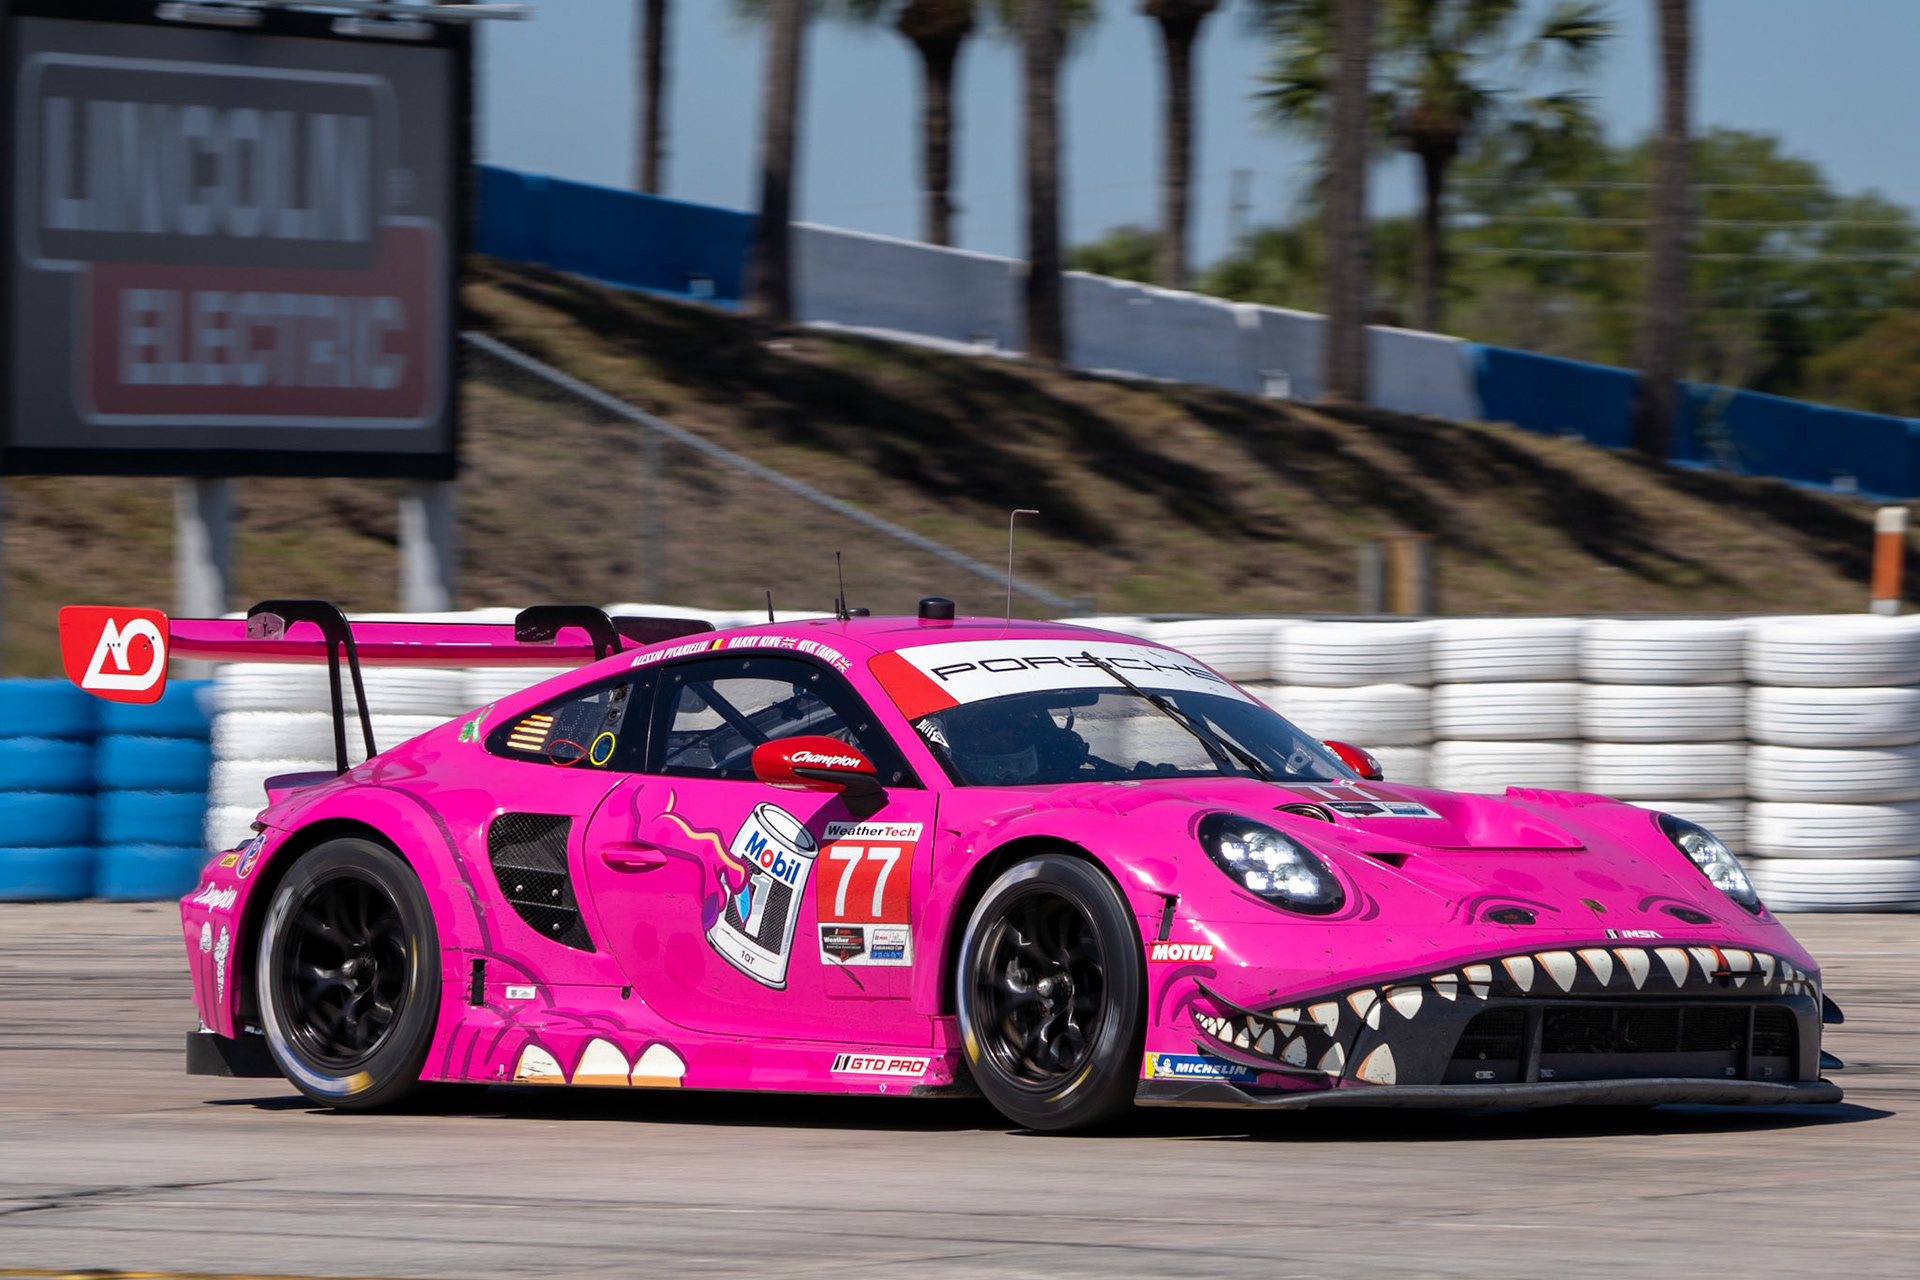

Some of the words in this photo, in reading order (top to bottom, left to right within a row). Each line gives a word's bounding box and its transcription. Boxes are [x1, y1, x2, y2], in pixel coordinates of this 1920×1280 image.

[41, 97, 372, 241] LINCOLN
[117, 287, 407, 389] ELECTRIC
[728, 636, 761, 649] HARRY
[758, 635, 784, 648] KING
[796, 639, 820, 654] NICK
[630, 649, 665, 668] ALESSIO
[930, 655, 1227, 686] PORSCHE
[791, 751, 861, 768] Champion
[827, 824, 917, 837] WeatherTech
[744, 831, 801, 885] Mobil
[829, 846, 902, 918] 77
[745, 872, 774, 939] 1
[1621, 929, 1664, 939] IMSA
[1151, 944, 1214, 961] MOTUL
[850, 1058, 885, 1071] GTD
[887, 1060, 925, 1073] PRO
[1175, 1062, 1248, 1076] MICHELIN
